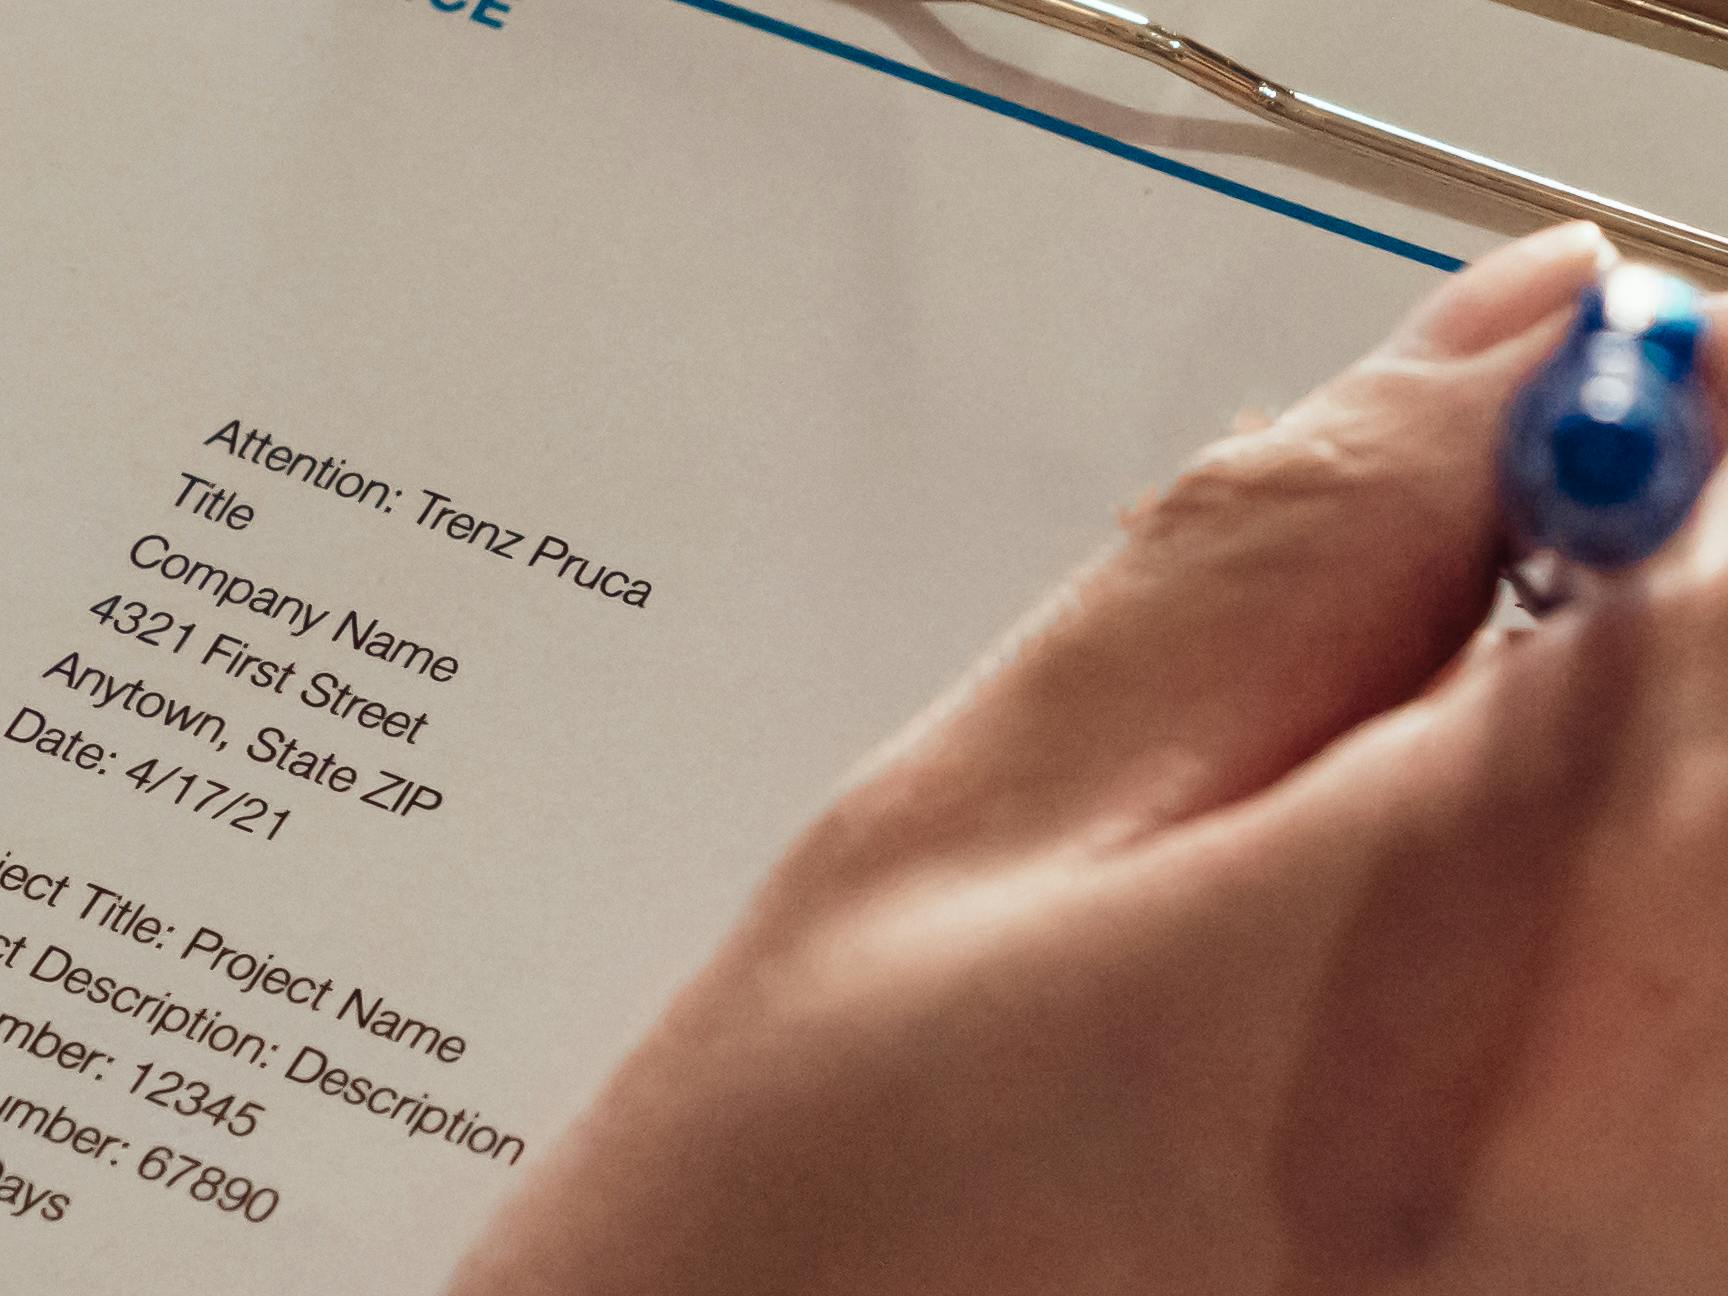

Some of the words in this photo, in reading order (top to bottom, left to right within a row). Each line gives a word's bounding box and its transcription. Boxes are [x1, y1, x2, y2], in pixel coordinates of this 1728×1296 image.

[173, 473, 255, 530] Title
[203, 418, 404, 514] Attention:
[414, 490, 524, 559] Trenz
[527, 536, 654, 608] Pruca
[88, 593, 197, 654] 4321
[201, 634, 296, 694] First
[300, 672, 429, 745] Street
[130, 534, 330, 637] Company
[332, 611, 459, 683] Name
[3, 707, 117, 775] Date:
[124, 758, 292, 841] 4/17/21
[42, 652, 230, 751] Anytown,
[246, 727, 357, 793] State
[361, 771, 443, 818] ZIP
[74, 882, 176, 951] Title:
[180, 927, 332, 1012] Project
[337, 988, 467, 1064] Name
[29, 946, 278, 1069] Description:
[285, 1046, 526, 1167] Description
[130, 1062, 266, 1138] 12345
[137, 1145, 280, 1224] 67890
